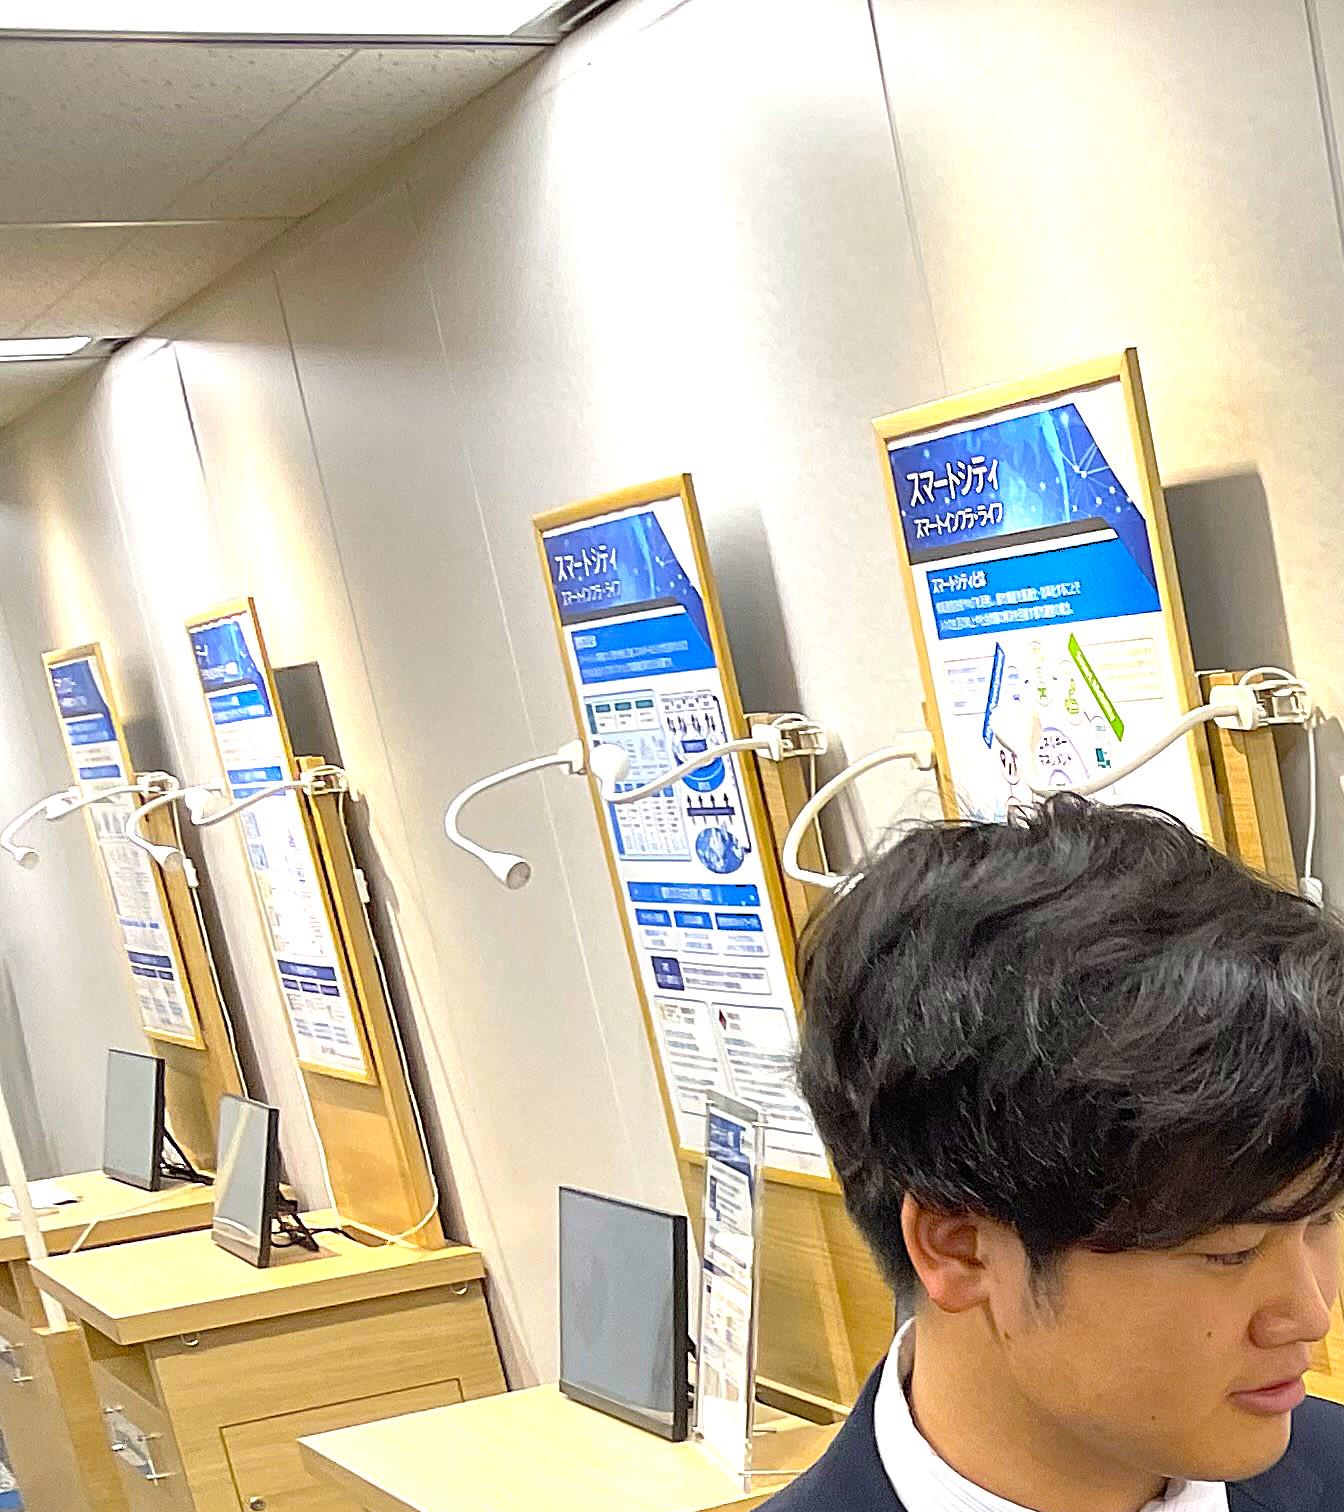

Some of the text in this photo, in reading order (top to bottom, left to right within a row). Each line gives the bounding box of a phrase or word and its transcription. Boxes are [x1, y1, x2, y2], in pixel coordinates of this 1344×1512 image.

[906, 455, 999, 508] スマートシティ
[554, 544, 617, 582] スマートシティ
